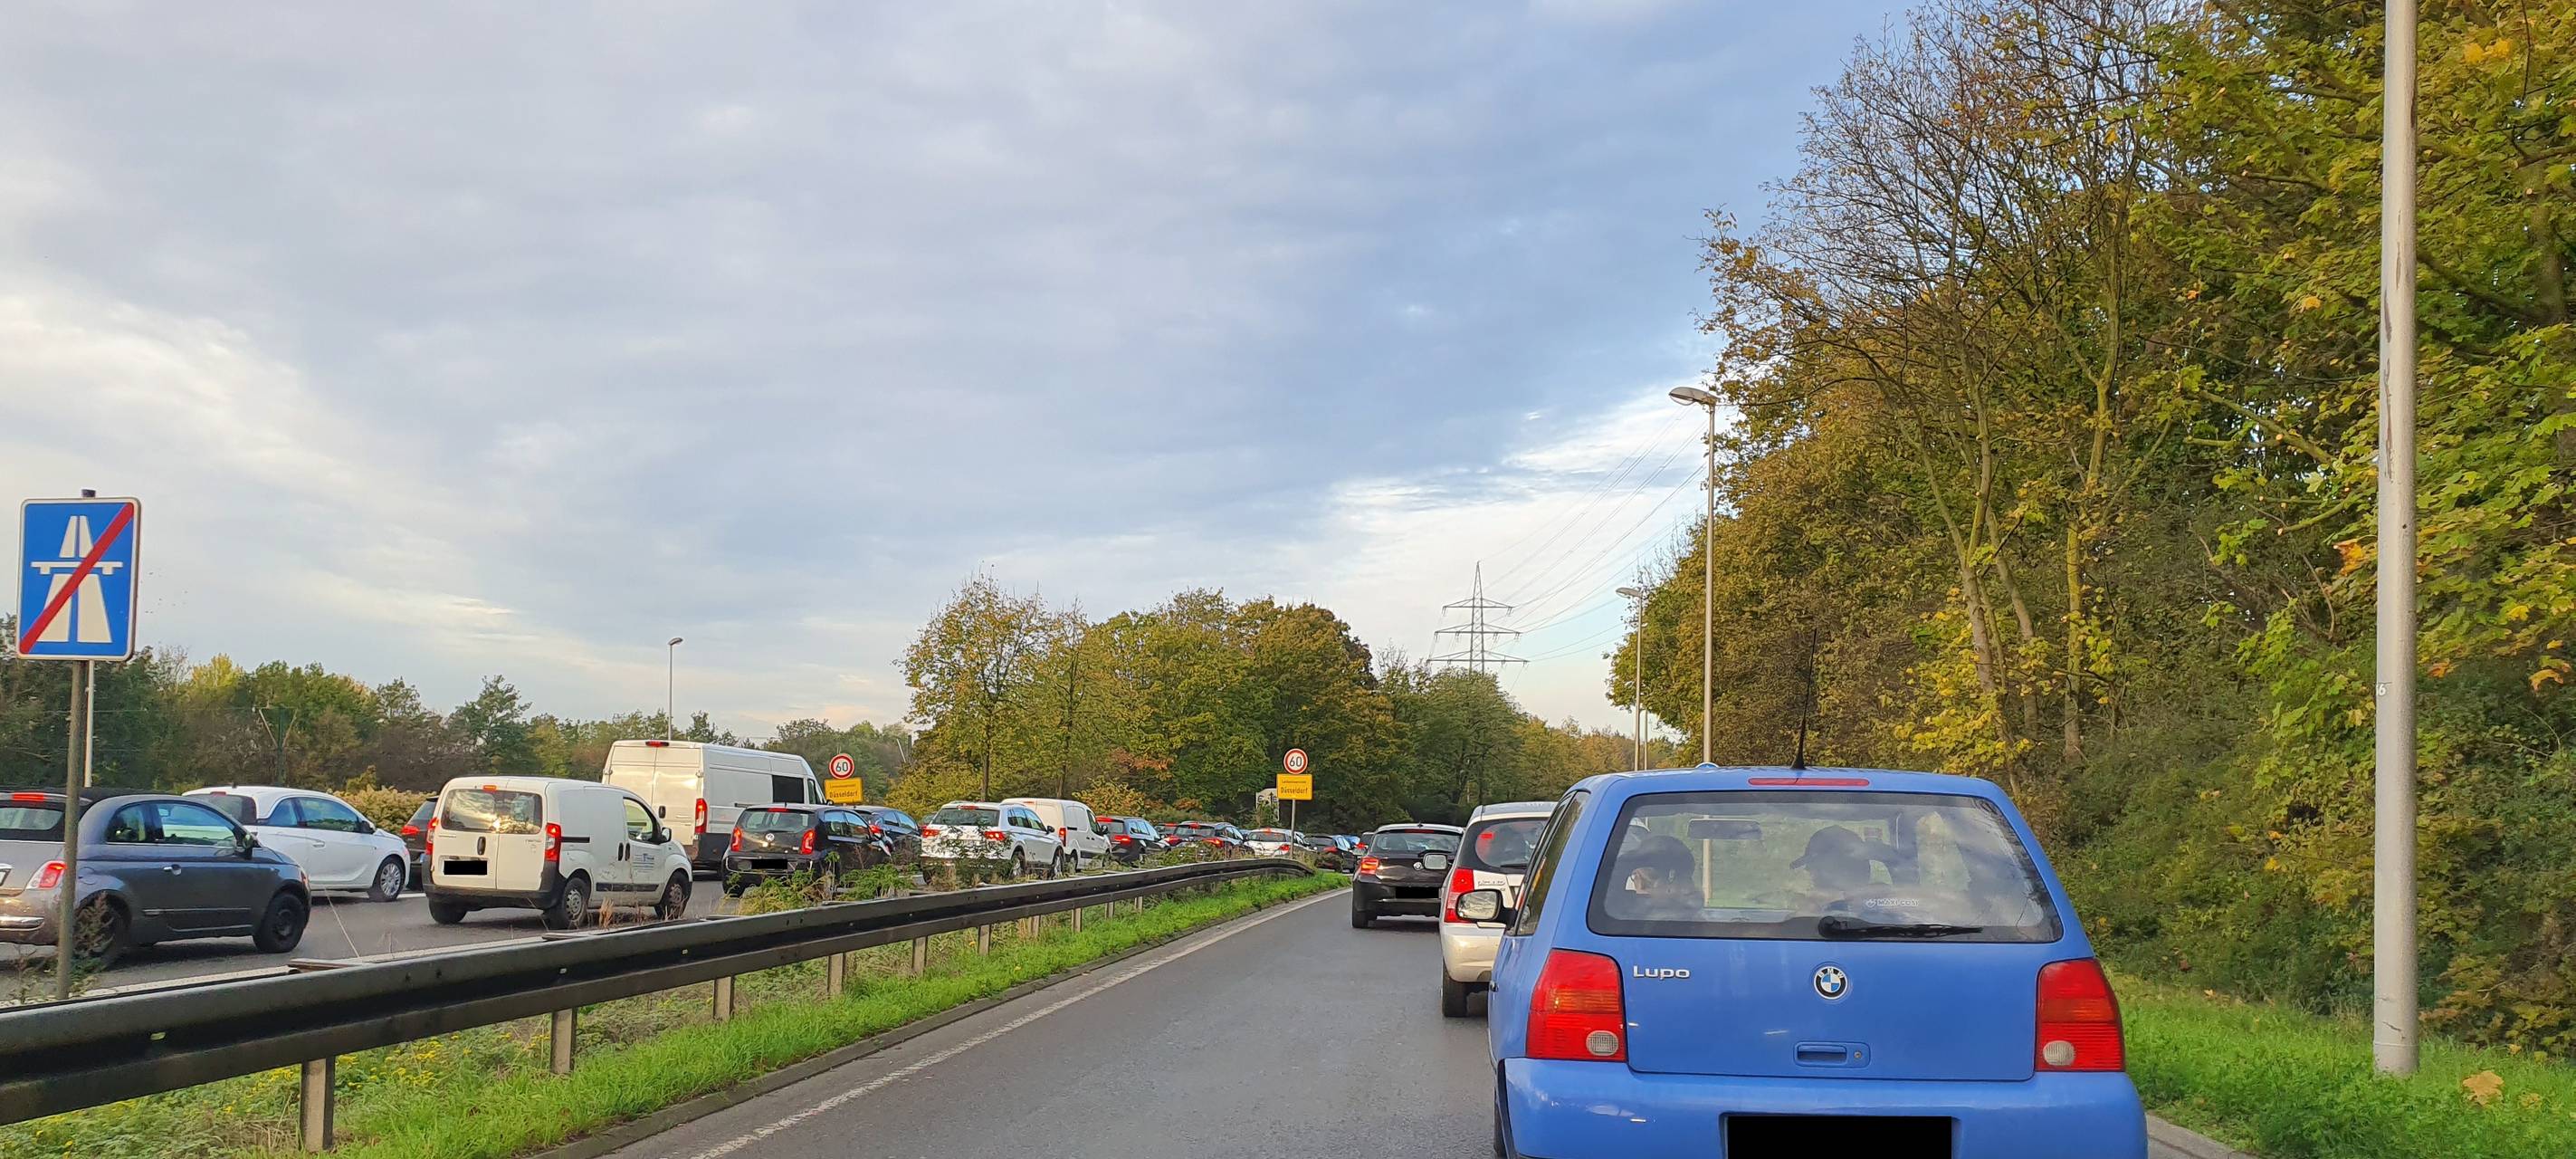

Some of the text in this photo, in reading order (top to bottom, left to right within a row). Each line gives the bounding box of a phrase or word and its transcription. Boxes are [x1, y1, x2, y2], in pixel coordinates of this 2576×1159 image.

[835, 761, 848, 771] 60
[1289, 755, 1302, 767] 60
[1633, 965, 1690, 980] Lupo
